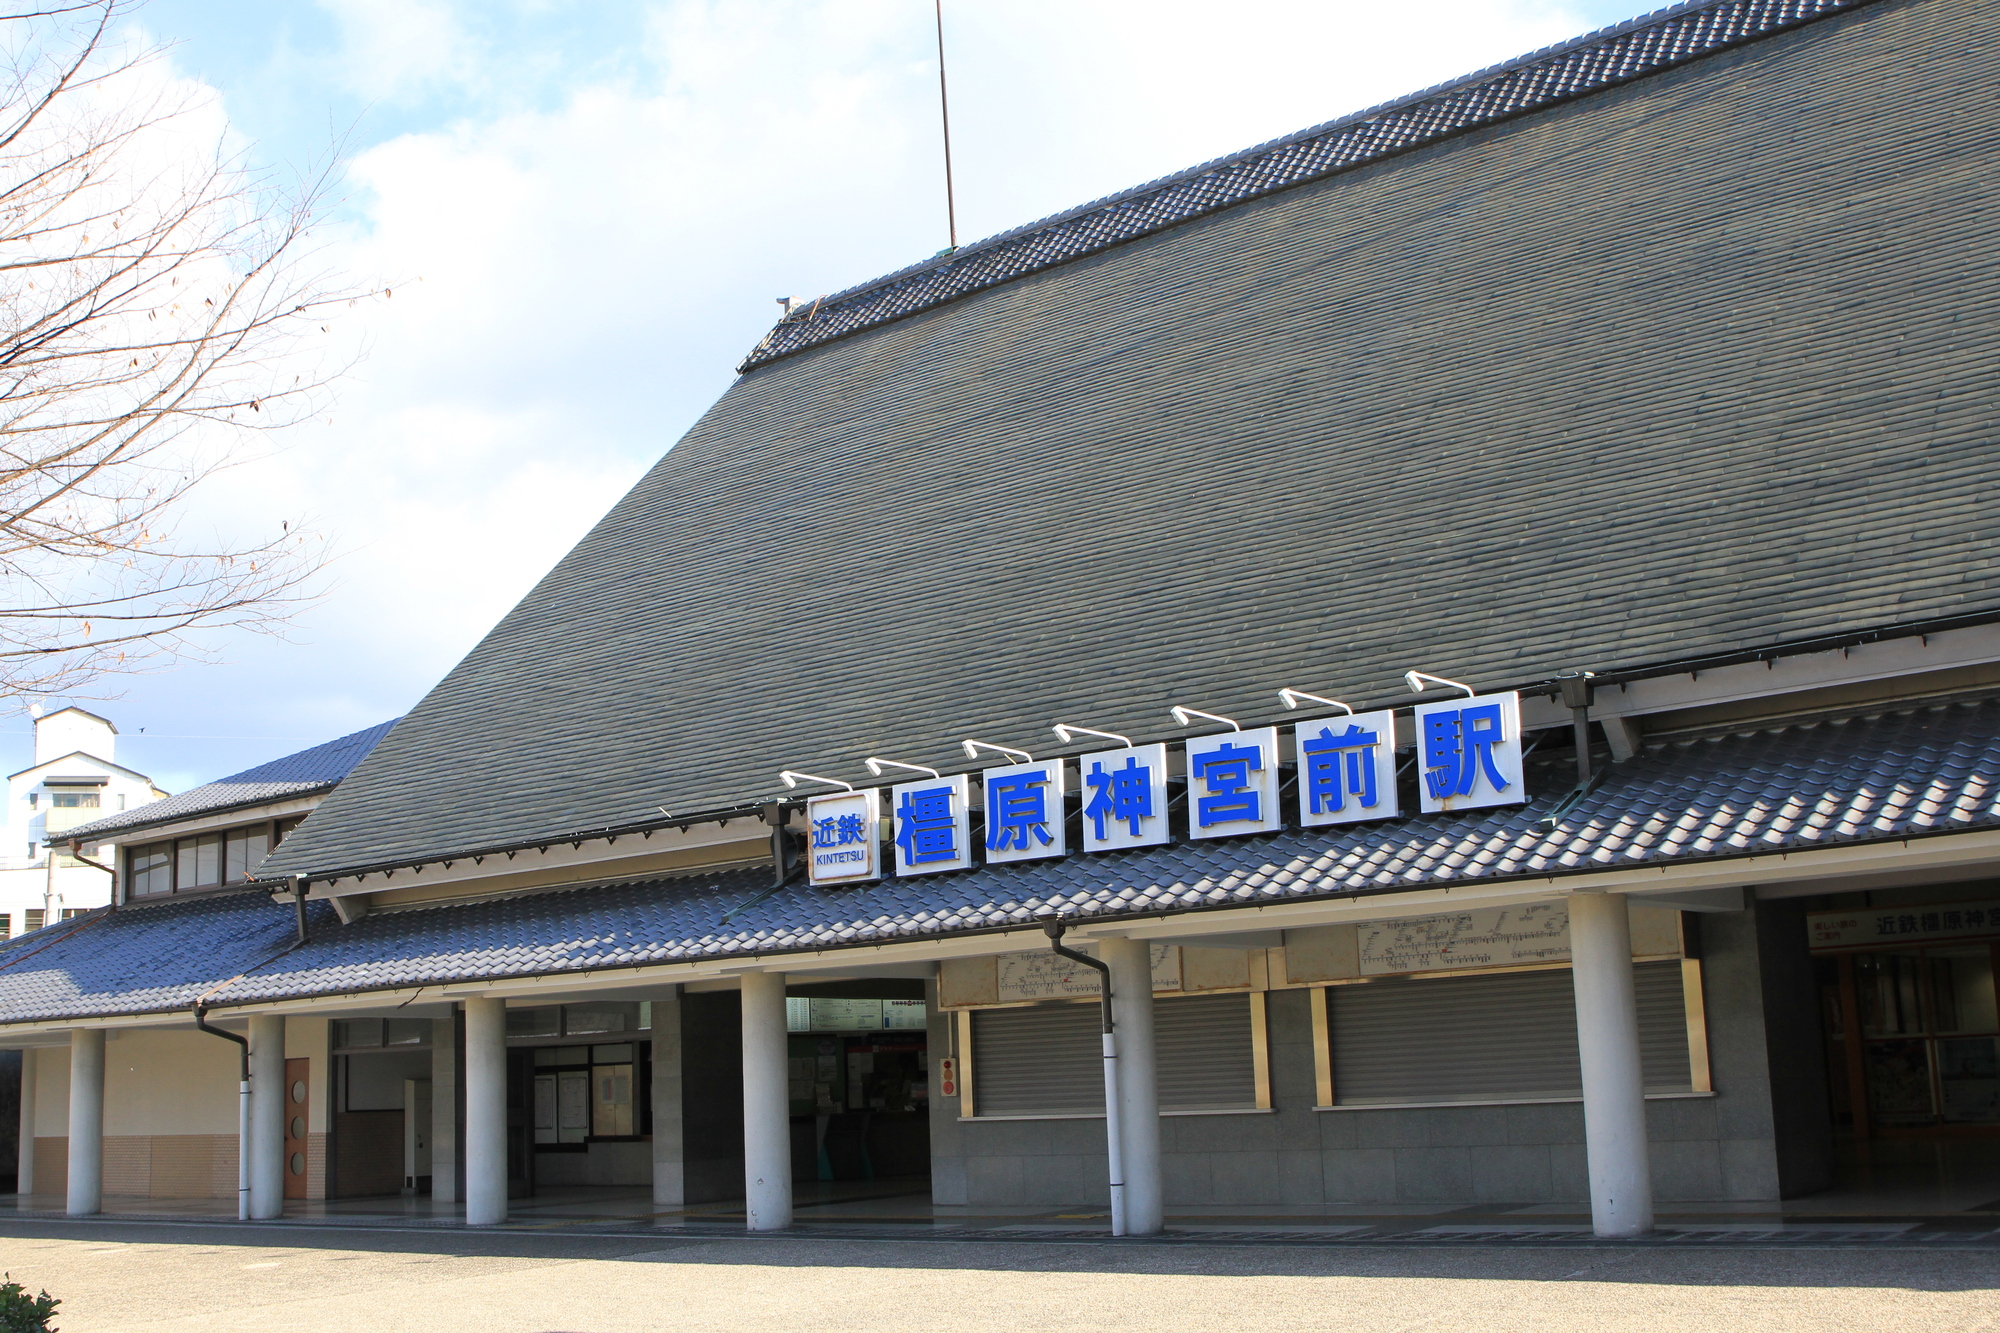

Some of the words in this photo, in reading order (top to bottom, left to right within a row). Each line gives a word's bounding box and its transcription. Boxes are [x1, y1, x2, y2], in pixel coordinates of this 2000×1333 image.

[895, 703, 1511, 866] 橿原神宮前駅
[812, 813, 867, 850] 近鉄
[816, 850, 864, 866] KINTETSU
[1814, 919, 1857, 931] 楽しい旅の
[1816, 931, 1841, 941] ご案内
